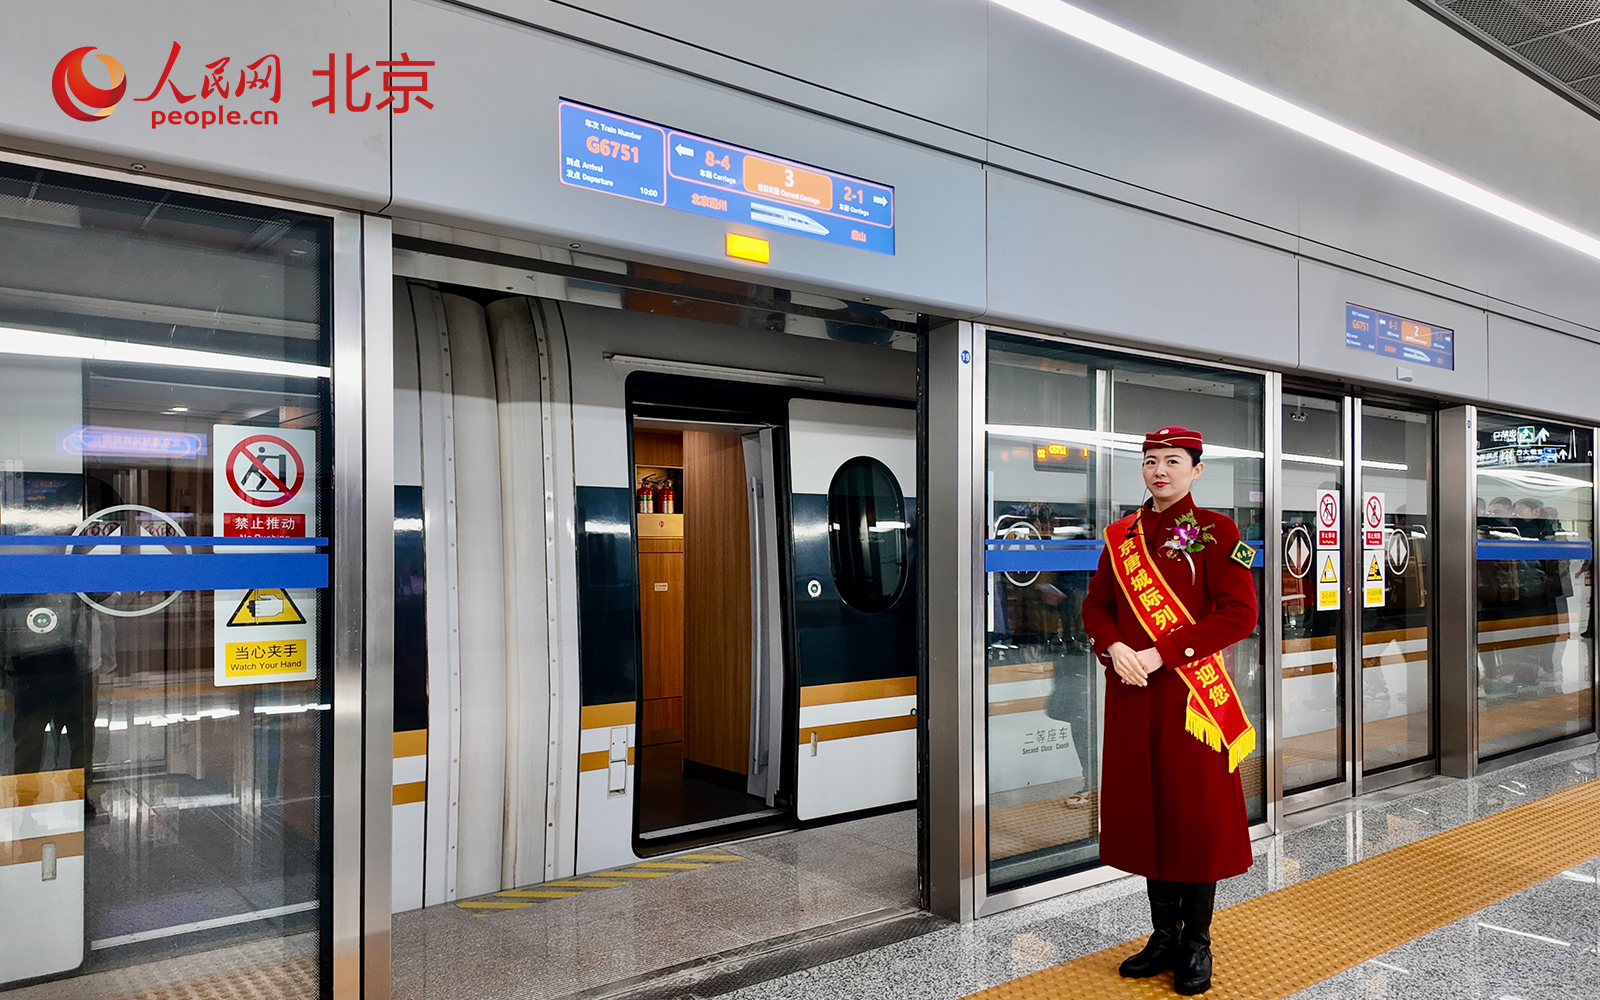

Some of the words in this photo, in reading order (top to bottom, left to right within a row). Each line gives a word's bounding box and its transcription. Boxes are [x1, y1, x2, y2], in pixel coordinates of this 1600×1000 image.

[600, 122, 617, 135] Train
[617, 127, 642, 140] Number
[586, 135, 639, 164] G6751
[581, 161, 603, 173] Arrival
[705, 149, 731, 171] 8-4
[581, 173, 614, 187] Departure
[713, 172, 737, 185] Carriage
[784, 168, 795, 188] 3
[639, 186, 659, 198] 10:00
[843, 186, 864, 205] 2-1
[691, 193, 727, 211] 北京通州
[1353, 320, 1369, 331] G6751
[1414, 325, 1420, 337] 2
[961, 352, 970, 362] 19
[234, 516, 296, 530] 禁止推动
[235, 643, 298, 660] 当心夹手
[230, 662, 257, 671] Watch
[259, 662, 279, 670] Your
[280, 660, 302, 668] Hand
[1024, 727, 1068, 744] 二等座车
[1022, 746, 1039, 755] Second
[1055, 742, 1069, 750] Coach
